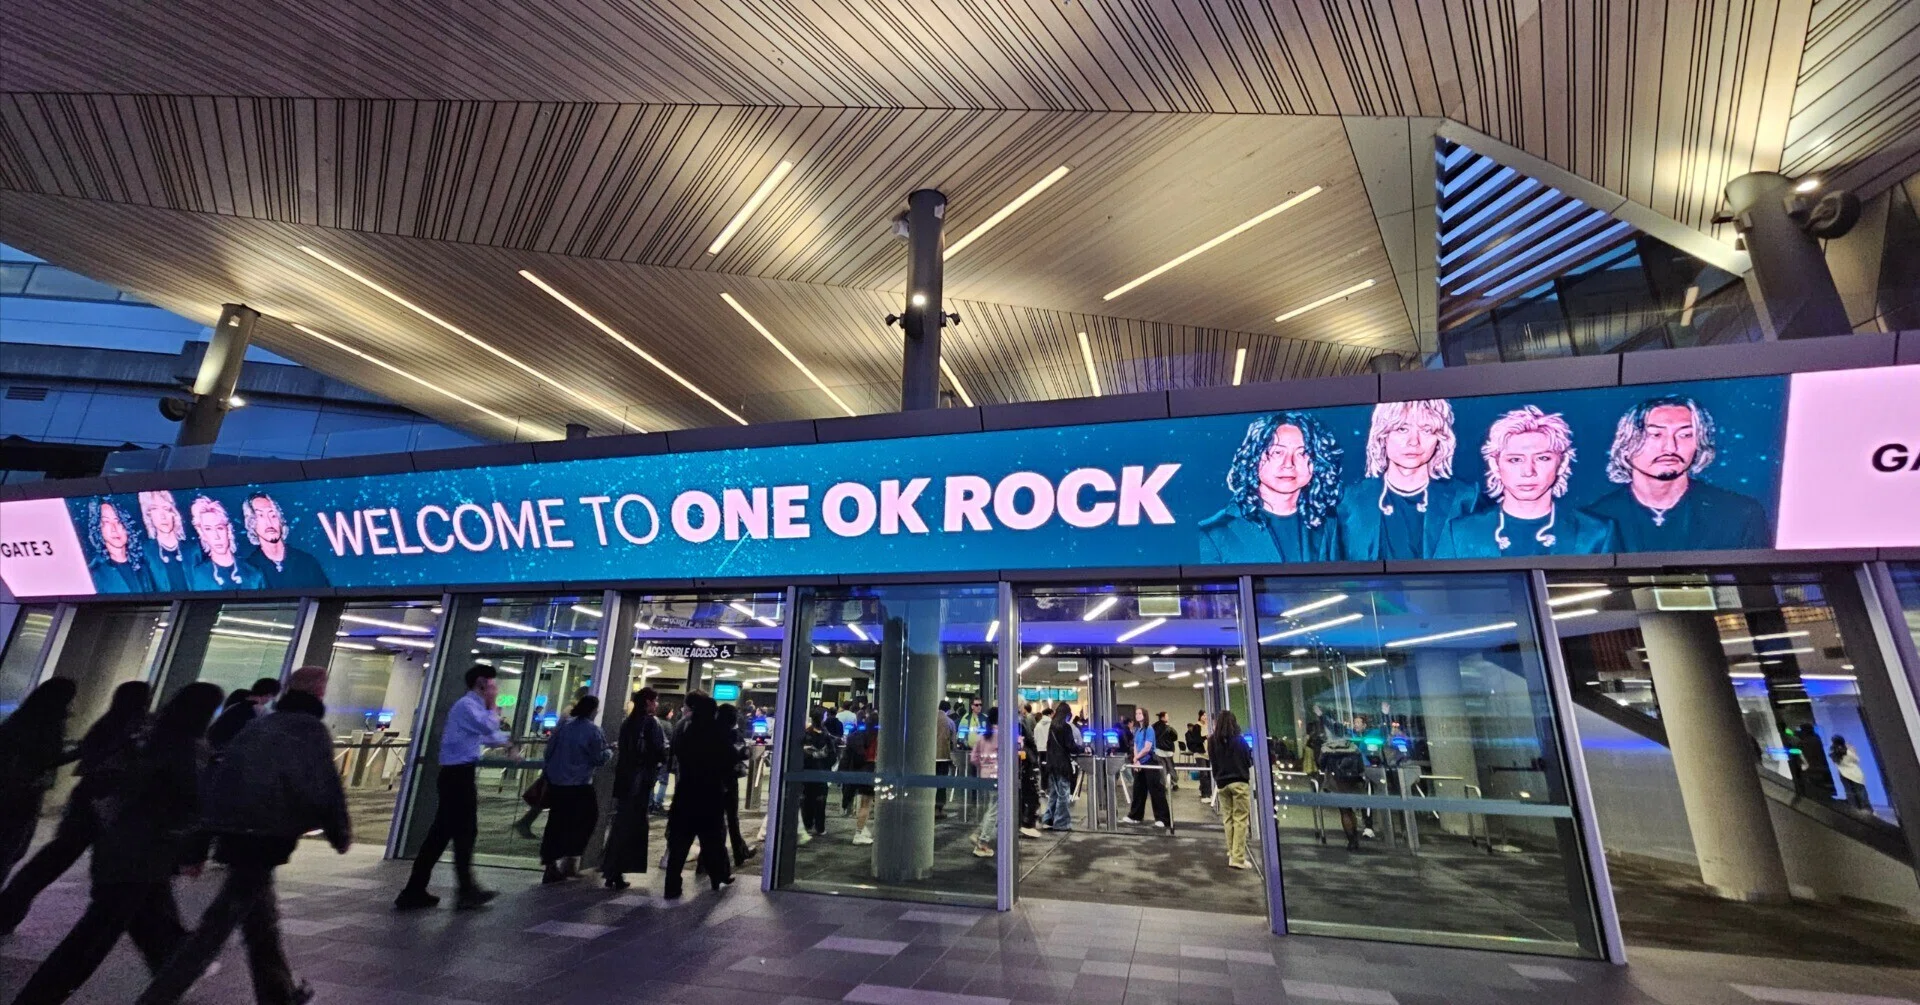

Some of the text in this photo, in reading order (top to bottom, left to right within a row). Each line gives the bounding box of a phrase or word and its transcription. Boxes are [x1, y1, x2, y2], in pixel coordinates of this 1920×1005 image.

[1872, 443, 1920, 473] G
[317, 463, 1182, 557] WELCOME TO ONE OK ROCK
[1, 540, 54, 558] GATE 3
[646, 645, 718, 658] ACCESSIBLE ACCESS
